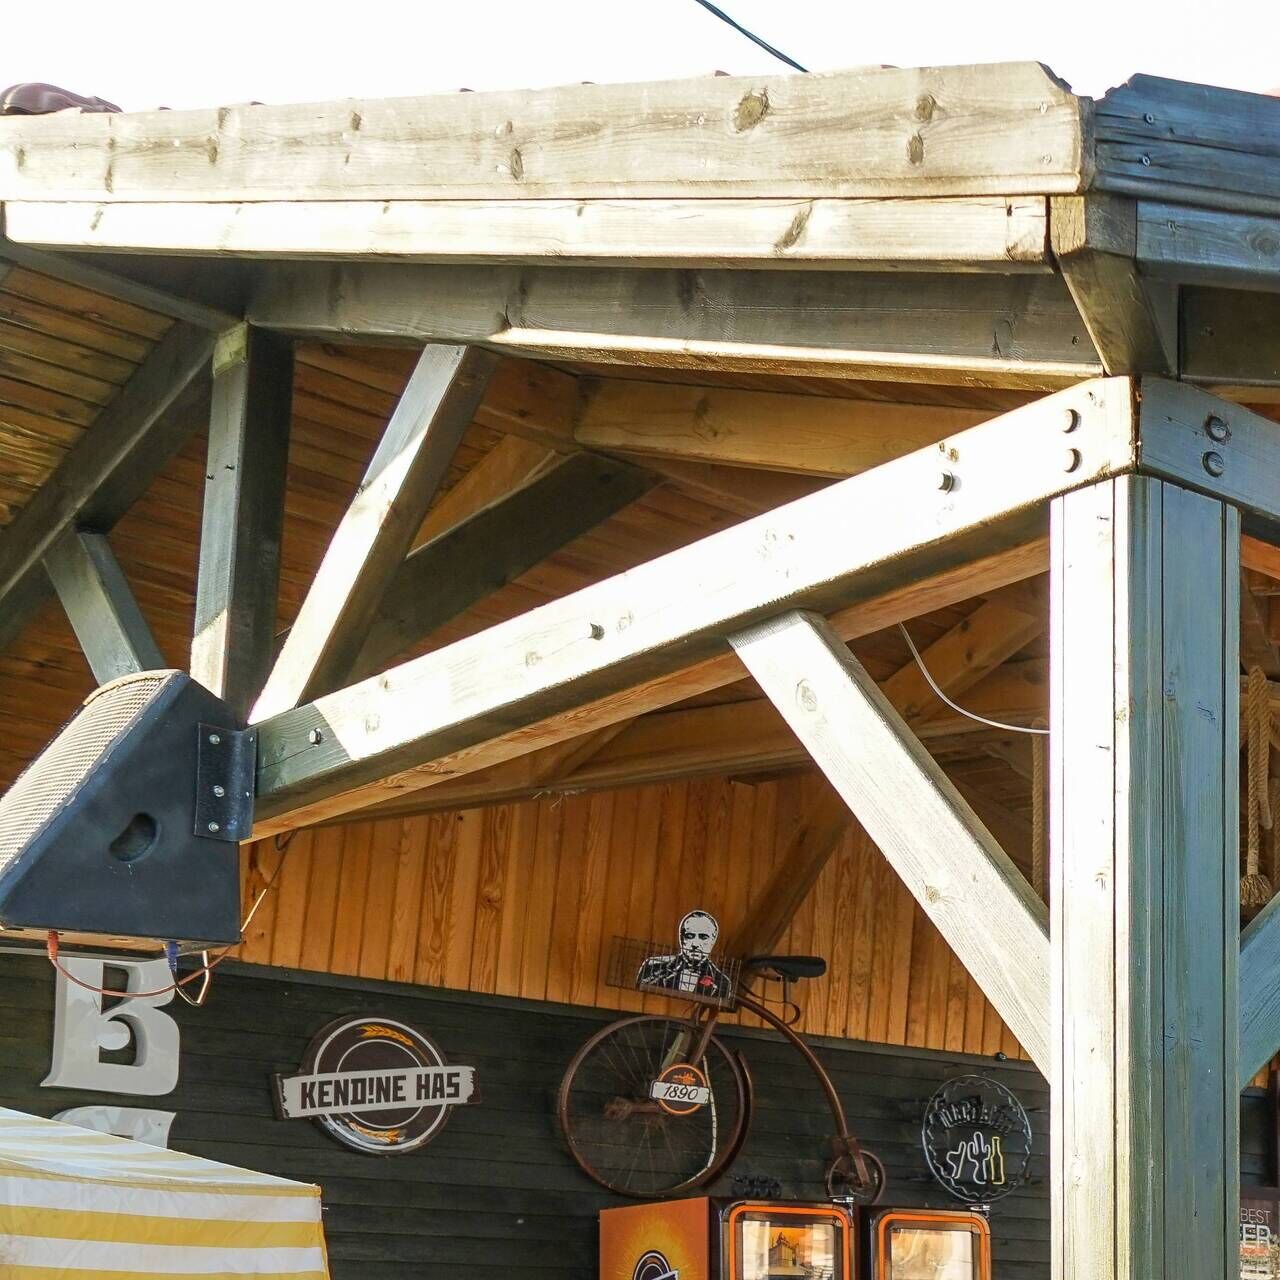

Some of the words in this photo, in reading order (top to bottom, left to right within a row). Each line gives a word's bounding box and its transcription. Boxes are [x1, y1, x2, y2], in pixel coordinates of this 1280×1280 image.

[416, 1072, 460, 1100] HAS
[663, 1085, 698, 1100] 1890
[1240, 1207, 1271, 1224] BEST
